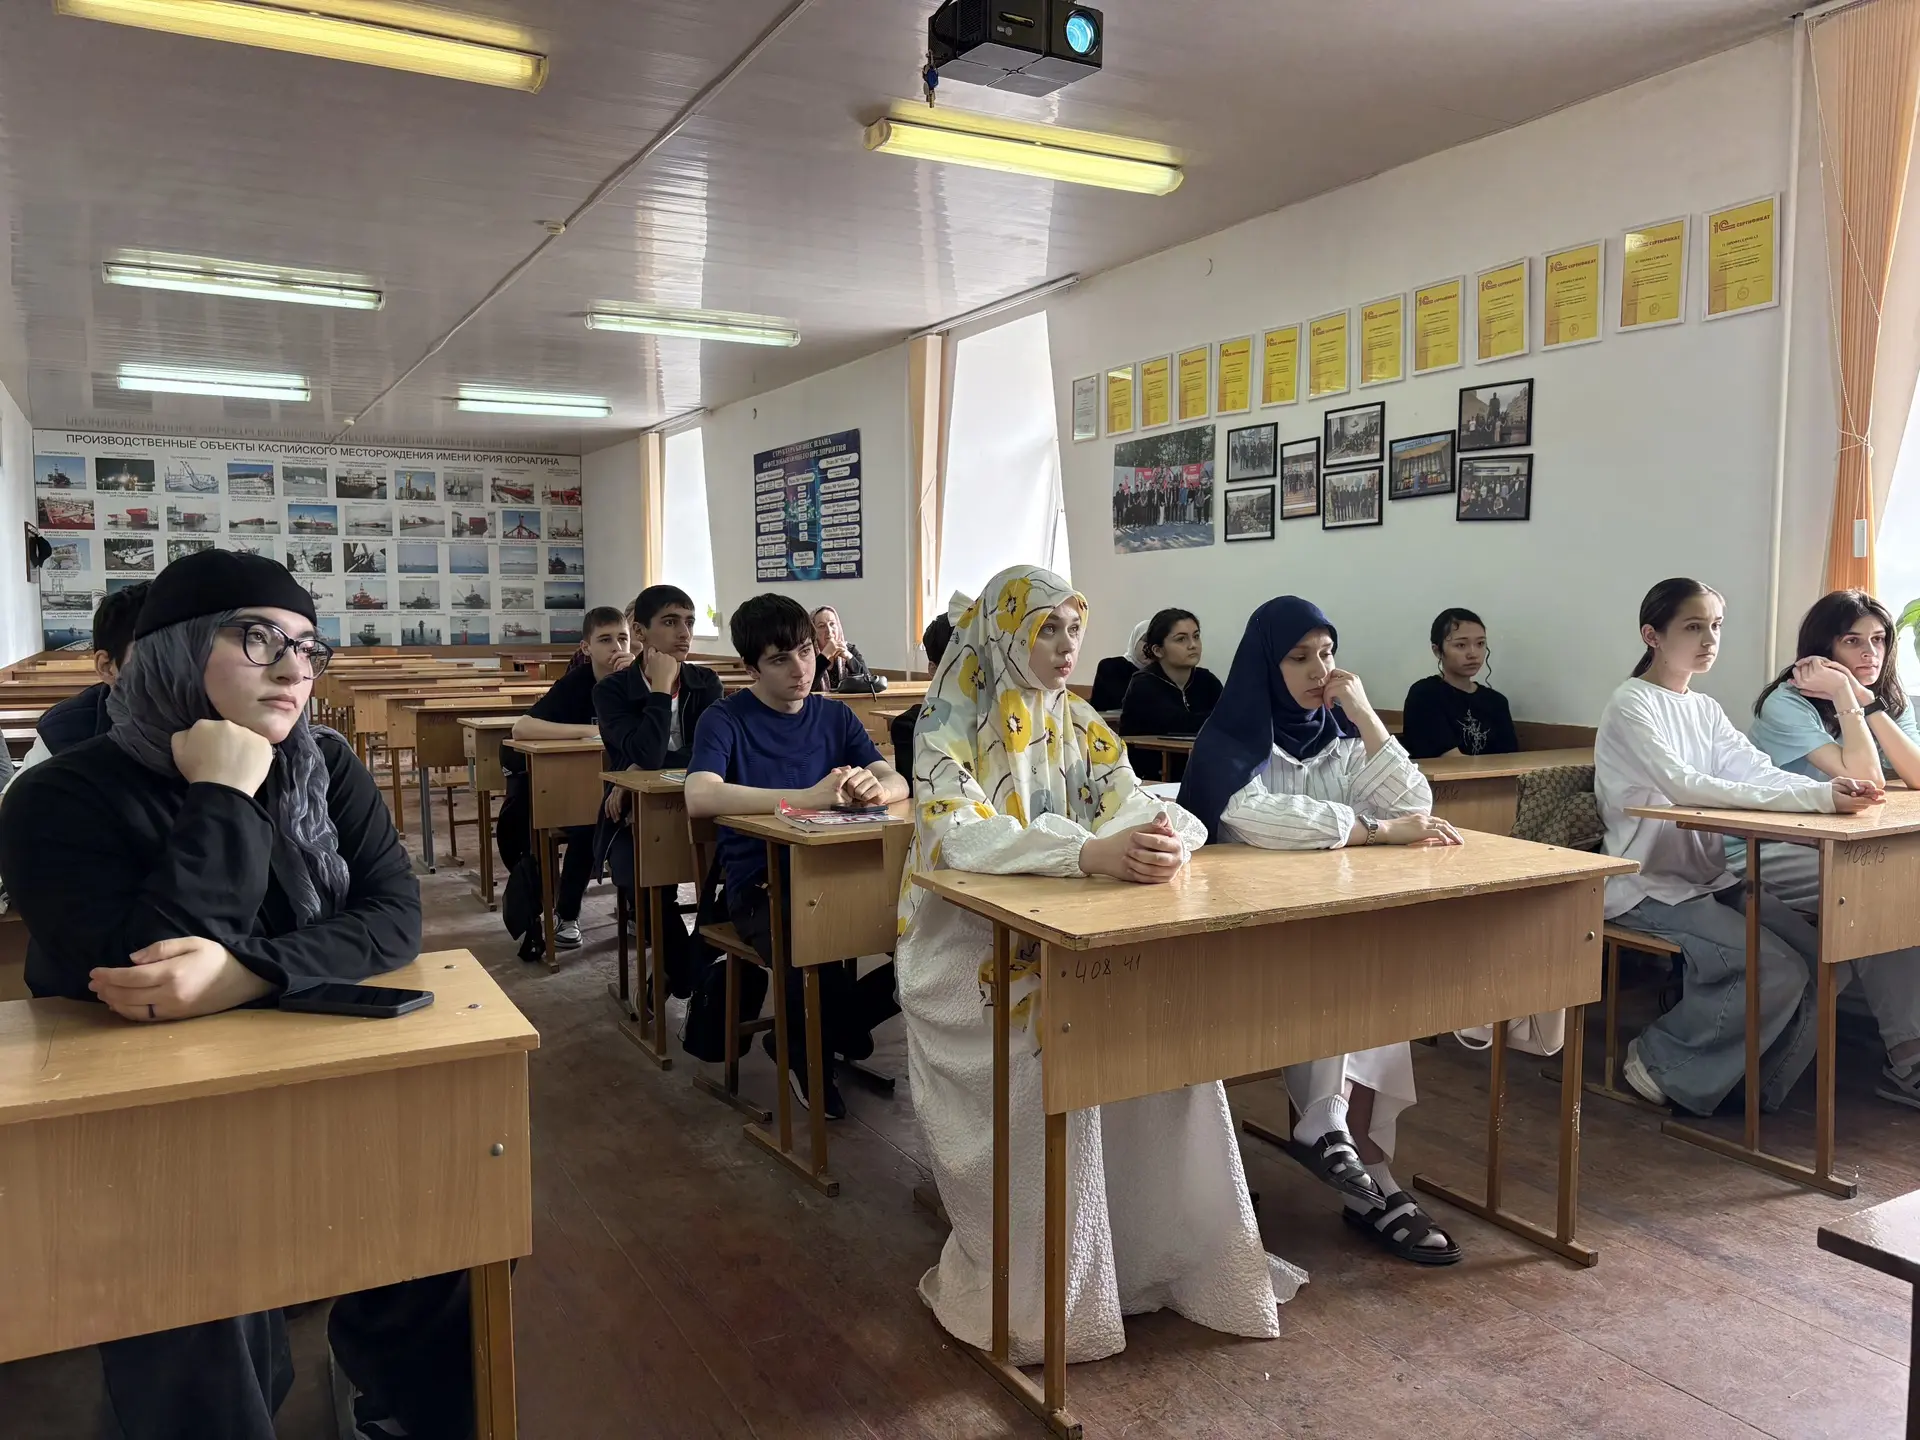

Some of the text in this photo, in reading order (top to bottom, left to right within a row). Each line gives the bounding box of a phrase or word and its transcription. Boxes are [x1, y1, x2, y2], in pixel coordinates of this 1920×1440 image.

[1736, 214, 1771, 228] СЕРТИФИКАТ
[66, 434, 197, 450] ПРОИЗВОДСТВЕННЫЕ
[200, 440, 255, 452] ОБЪЕКТЫ
[258, 443, 338, 456] КАСПИЙСКОГО
[340, 447, 434, 461] МЕСТОРОЖДЕНИЯ
[436, 452, 471, 463] ИМЕНИ
[473, 453, 503, 464] ЮРИЯ
[505, 454, 560, 466] КОРЧАГИНА
[1075, 953, 1141, 984] 408 41
